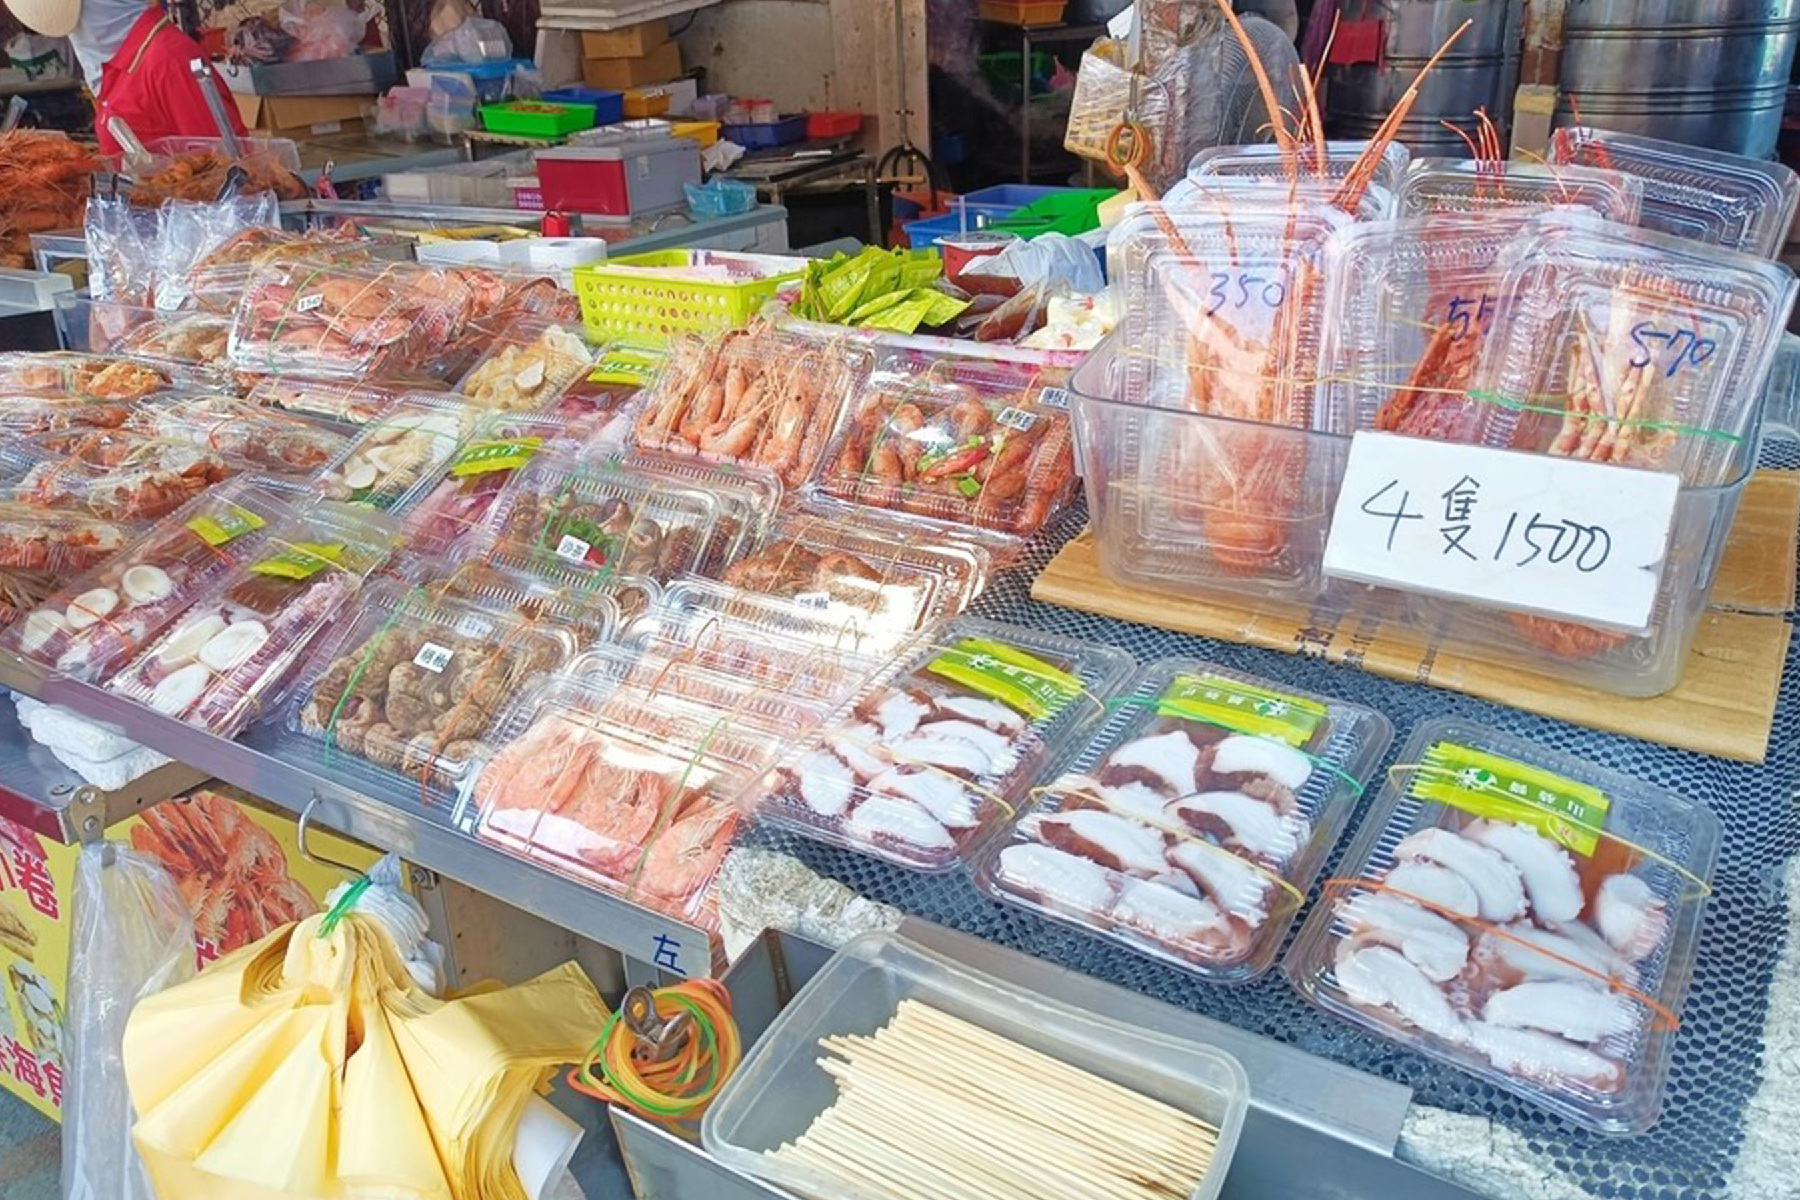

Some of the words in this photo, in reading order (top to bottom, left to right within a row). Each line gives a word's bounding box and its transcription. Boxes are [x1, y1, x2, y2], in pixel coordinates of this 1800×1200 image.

[1208, 273, 1285, 314] 350
[1629, 321, 1716, 377] 570
[1361, 475, 1611, 572] 4隻1500
[653, 934, 687, 976] 左
